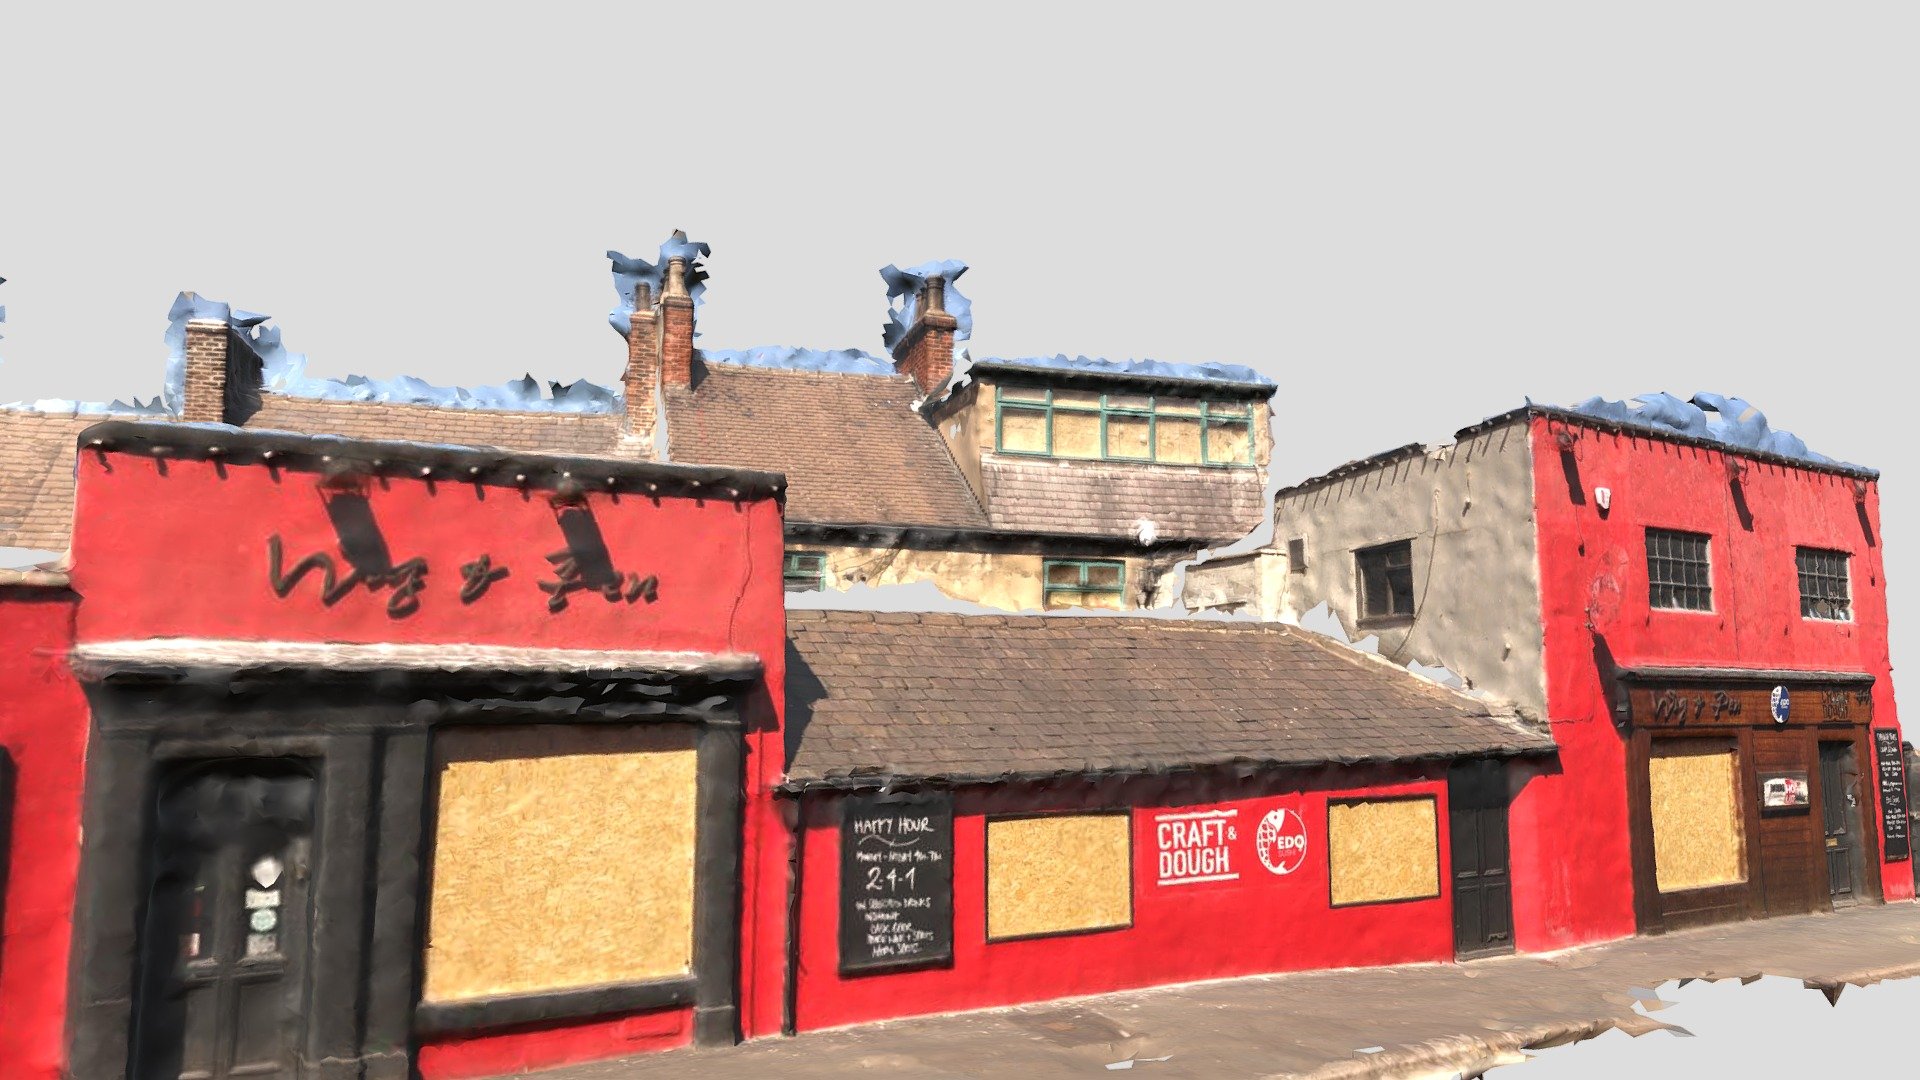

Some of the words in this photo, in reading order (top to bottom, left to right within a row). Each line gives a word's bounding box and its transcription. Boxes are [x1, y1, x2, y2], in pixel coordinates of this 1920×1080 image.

[460, 554, 510, 606] &
[854, 817, 893, 834] HAPPY
[899, 816, 935, 834] HOUR
[1157, 819, 1226, 849] CRAFT
[1226, 825, 1238, 840] &
[1158, 845, 1230, 878] DOUGH
